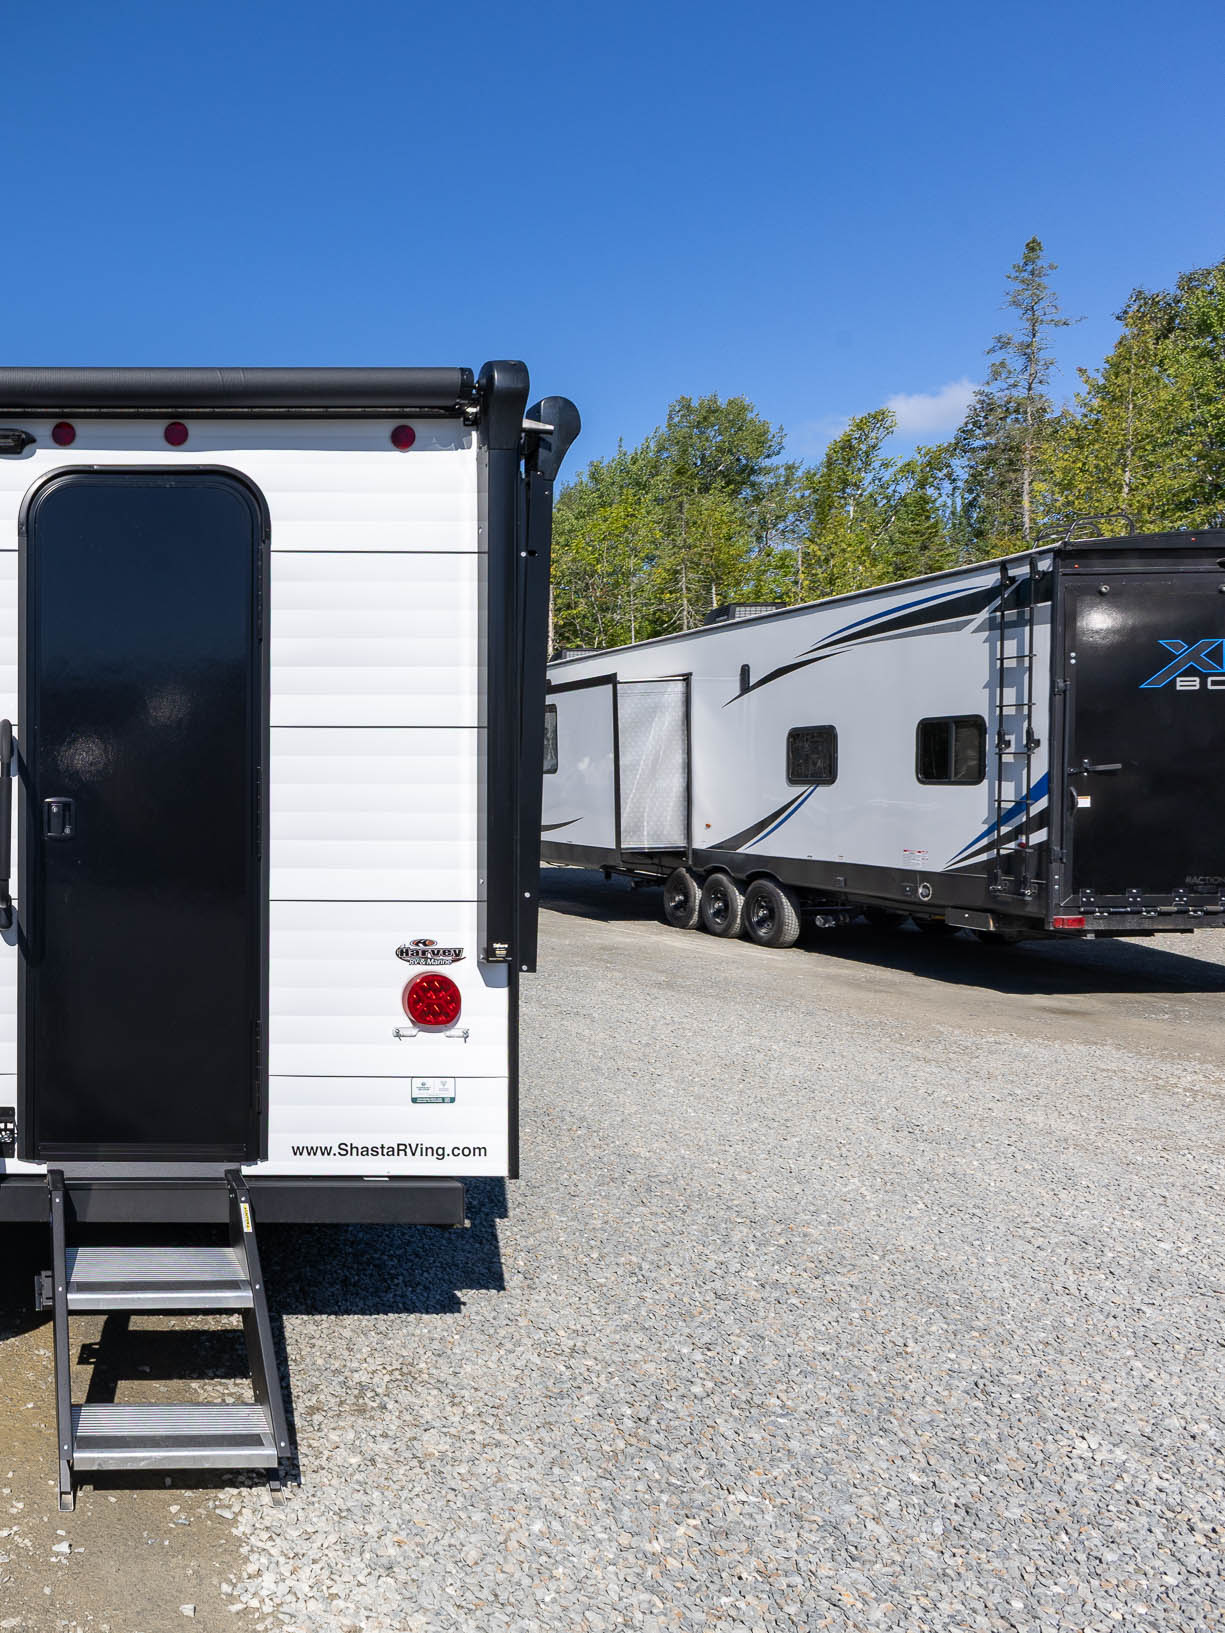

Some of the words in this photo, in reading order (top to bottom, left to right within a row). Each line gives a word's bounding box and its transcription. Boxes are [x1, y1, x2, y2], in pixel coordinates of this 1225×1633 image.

[1138, 638, 1225, 689] X
[398, 947, 464, 959] Harvey
[426, 958, 453, 966] Marine
[291, 1142, 487, 1160] www.ShastaRVing.com
